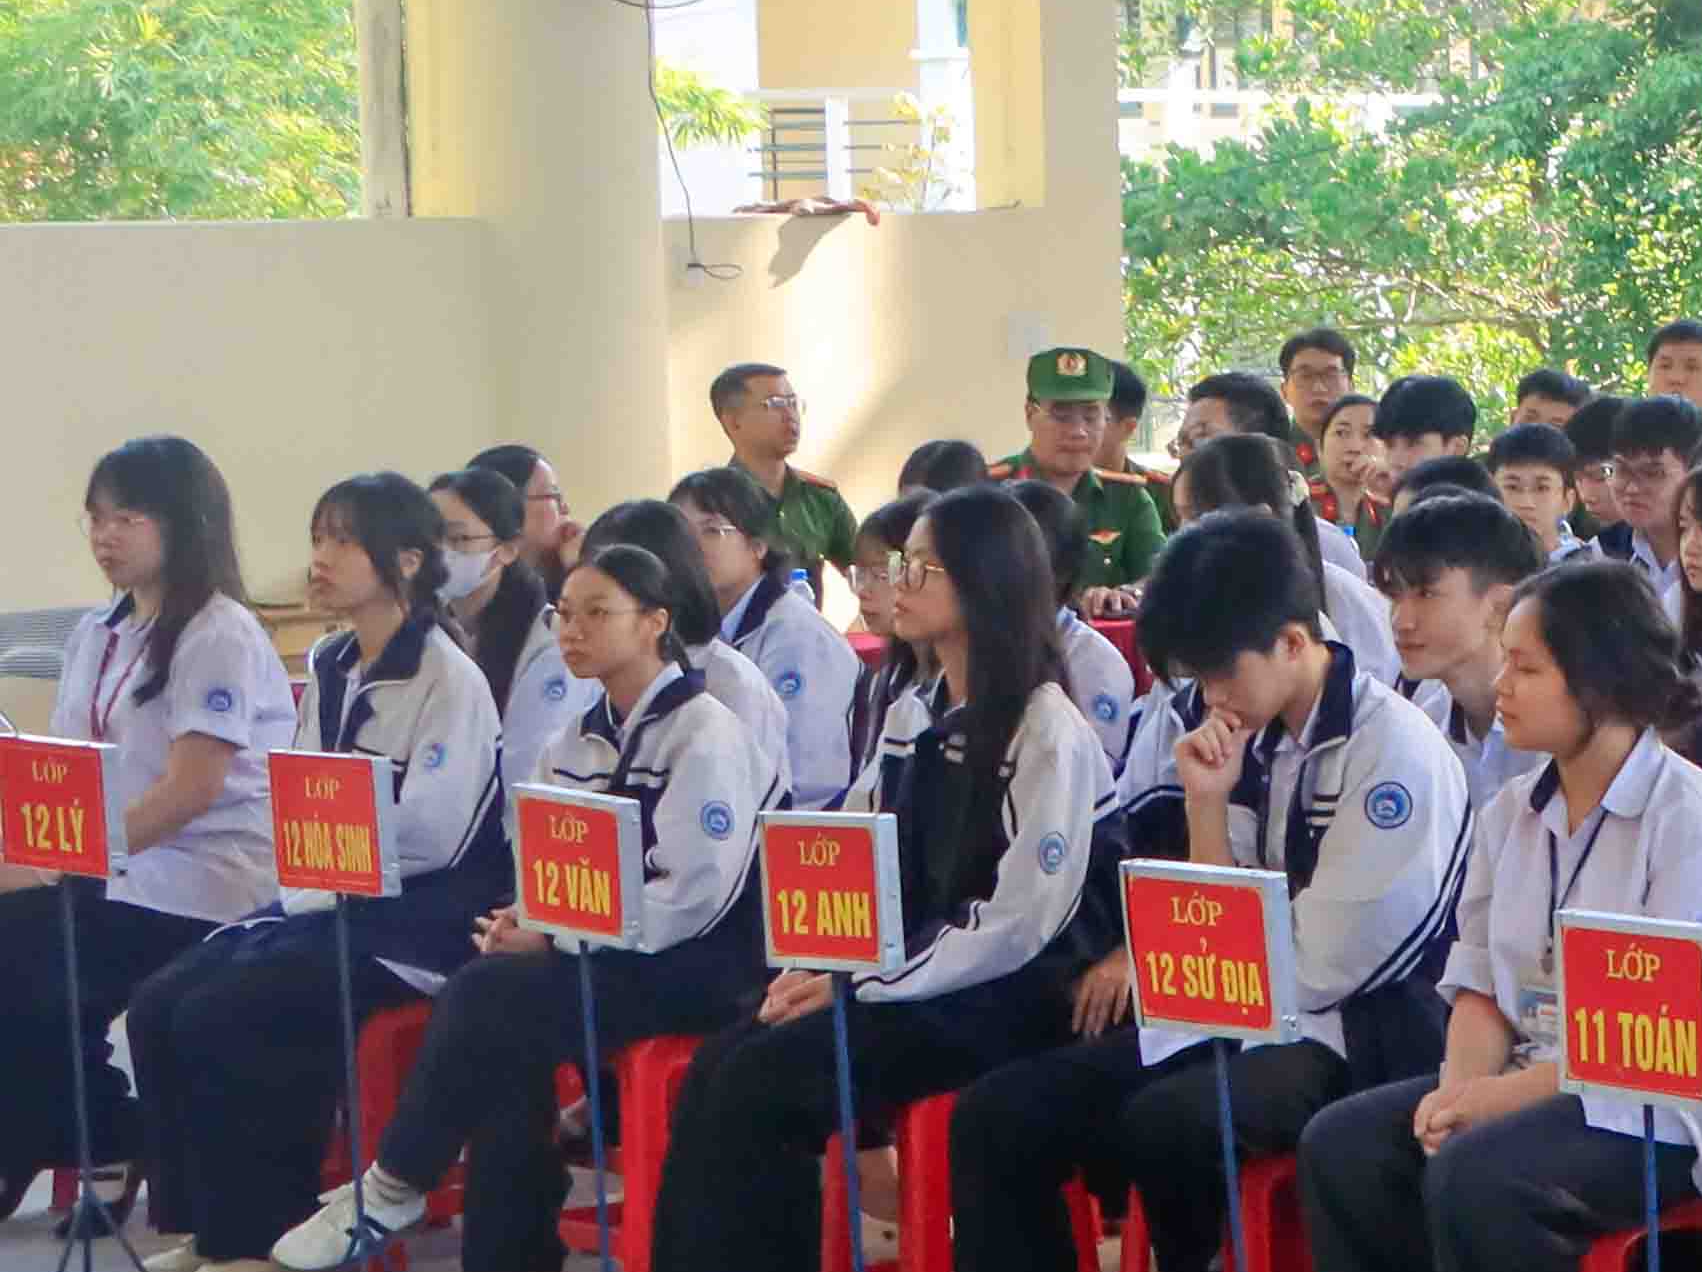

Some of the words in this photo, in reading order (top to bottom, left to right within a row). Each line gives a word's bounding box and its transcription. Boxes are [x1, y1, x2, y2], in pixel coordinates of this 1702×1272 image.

[21, 803, 51, 849] 12
[57, 798, 84, 855] LÝ
[284, 821, 302, 867] 12
[336, 822, 372, 873] SINH
[549, 810, 589, 843] LỚP
[797, 831, 841, 866] LỚP
[533, 859, 560, 905] 12
[564, 856, 611, 917] VĂN
[1170, 890, 1223, 927] LỚP
[777, 889, 808, 935] 12
[816, 889, 872, 939] ANH
[1146, 951, 1176, 995] 12
[1182, 936, 1216, 1000] SỬ
[1220, 958, 1265, 1016] ĐỊA
[1606, 943, 1661, 982] LỚP
[1575, 1008, 1605, 1064] 11
[1616, 1004, 1697, 1078] TOÁN
